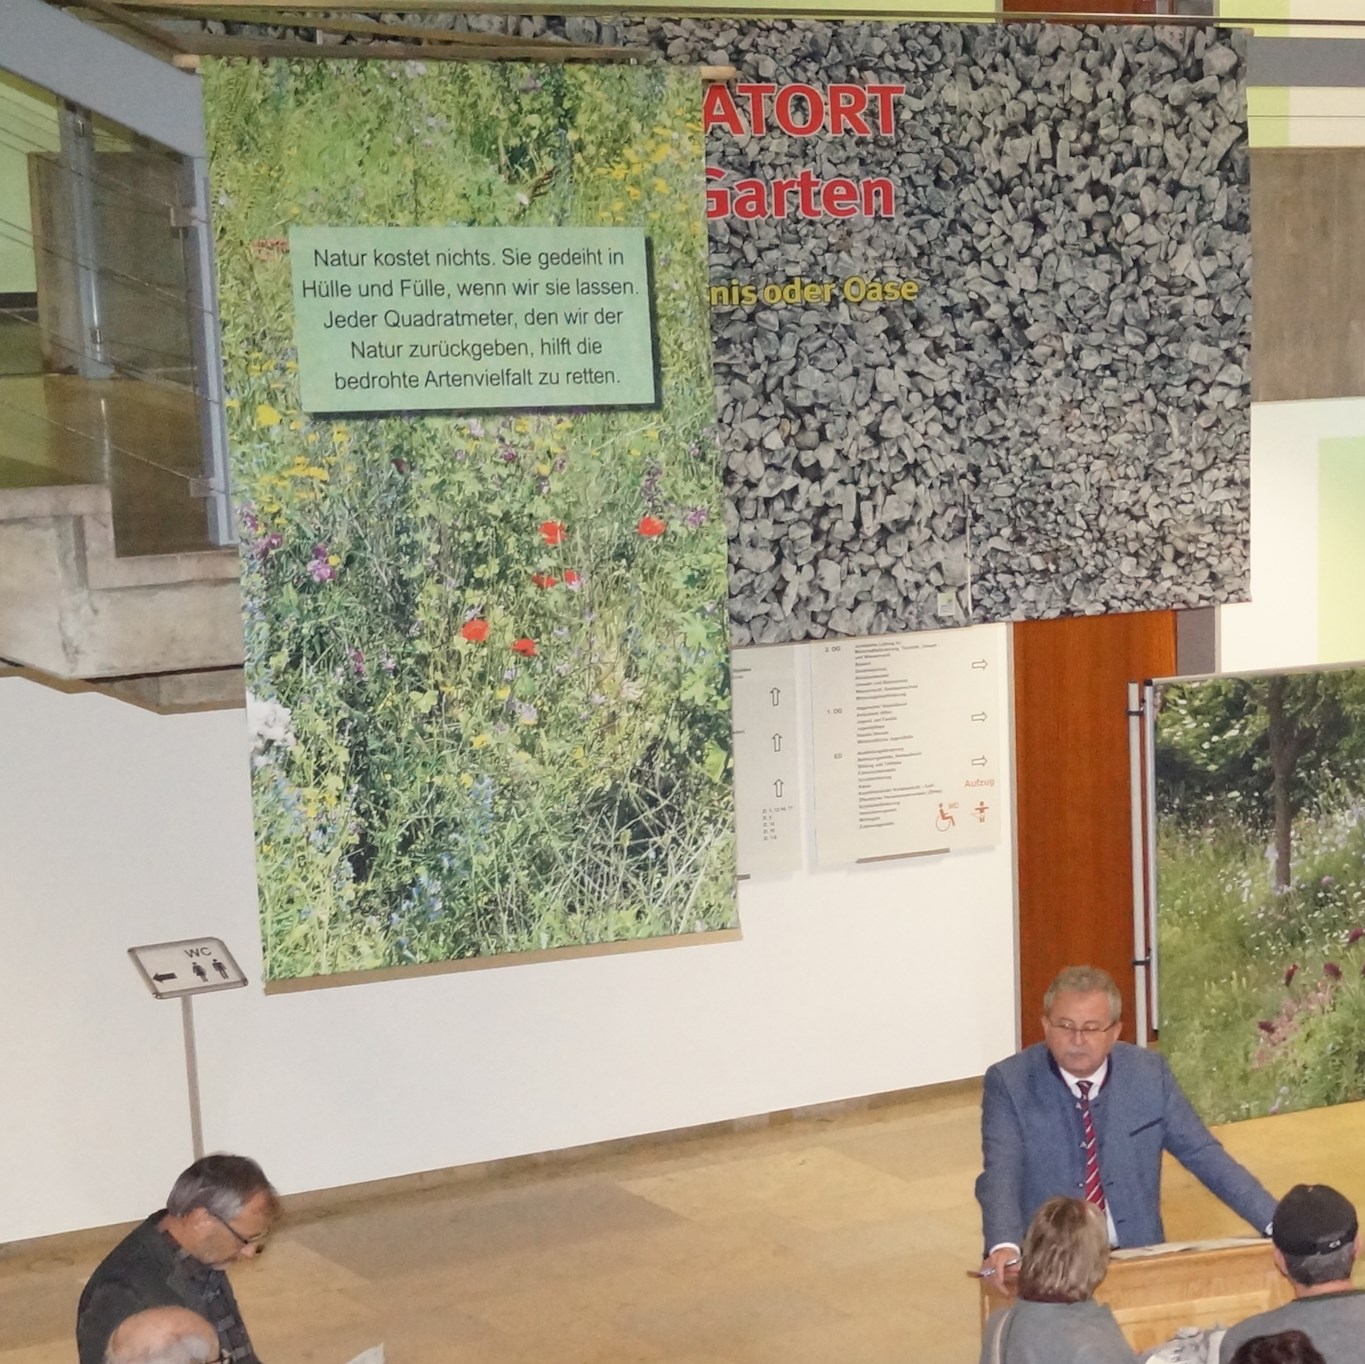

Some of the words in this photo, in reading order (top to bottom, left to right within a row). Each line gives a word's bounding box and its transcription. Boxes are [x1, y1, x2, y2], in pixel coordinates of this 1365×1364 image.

[314, 249, 367, 267] Natur
[374, 248, 431, 267] kostet
[436, 248, 496, 267] nichts.
[502, 247, 532, 266] Sie
[538, 247, 603, 270] gedeiht
[608, 247, 624, 265] in
[302, 279, 352, 298] Hülle
[358, 279, 394, 298] und
[400, 278, 451, 299] Fülle,
[457, 282, 506, 297] wenn
[512, 278, 540, 296] wir
[546, 278, 570, 296] sie
[576, 277, 639, 296] lassen.
[763, 275, 836, 304] oder
[843, 275, 920, 303] Oase
[323, 310, 378, 329] Jeder
[384, 308, 518, 329] Quadratmeter,
[524, 308, 558, 326] den
[564, 307, 589, 325] wir
[594, 307, 624, 325] der
[351, 340, 403, 359] Natur
[409, 338, 535, 361] zurückgeben,
[540, 337, 572, 356] hilft
[577, 337, 603, 355] die
[335, 370, 419, 390] bedrohte
[424, 368, 533, 388] Artenvielfalt
[539, 371, 559, 386] zu
[566, 368, 621, 385] retten.
[965, 779, 995, 788] Aufzug
[184, 946, 213, 959] WC
